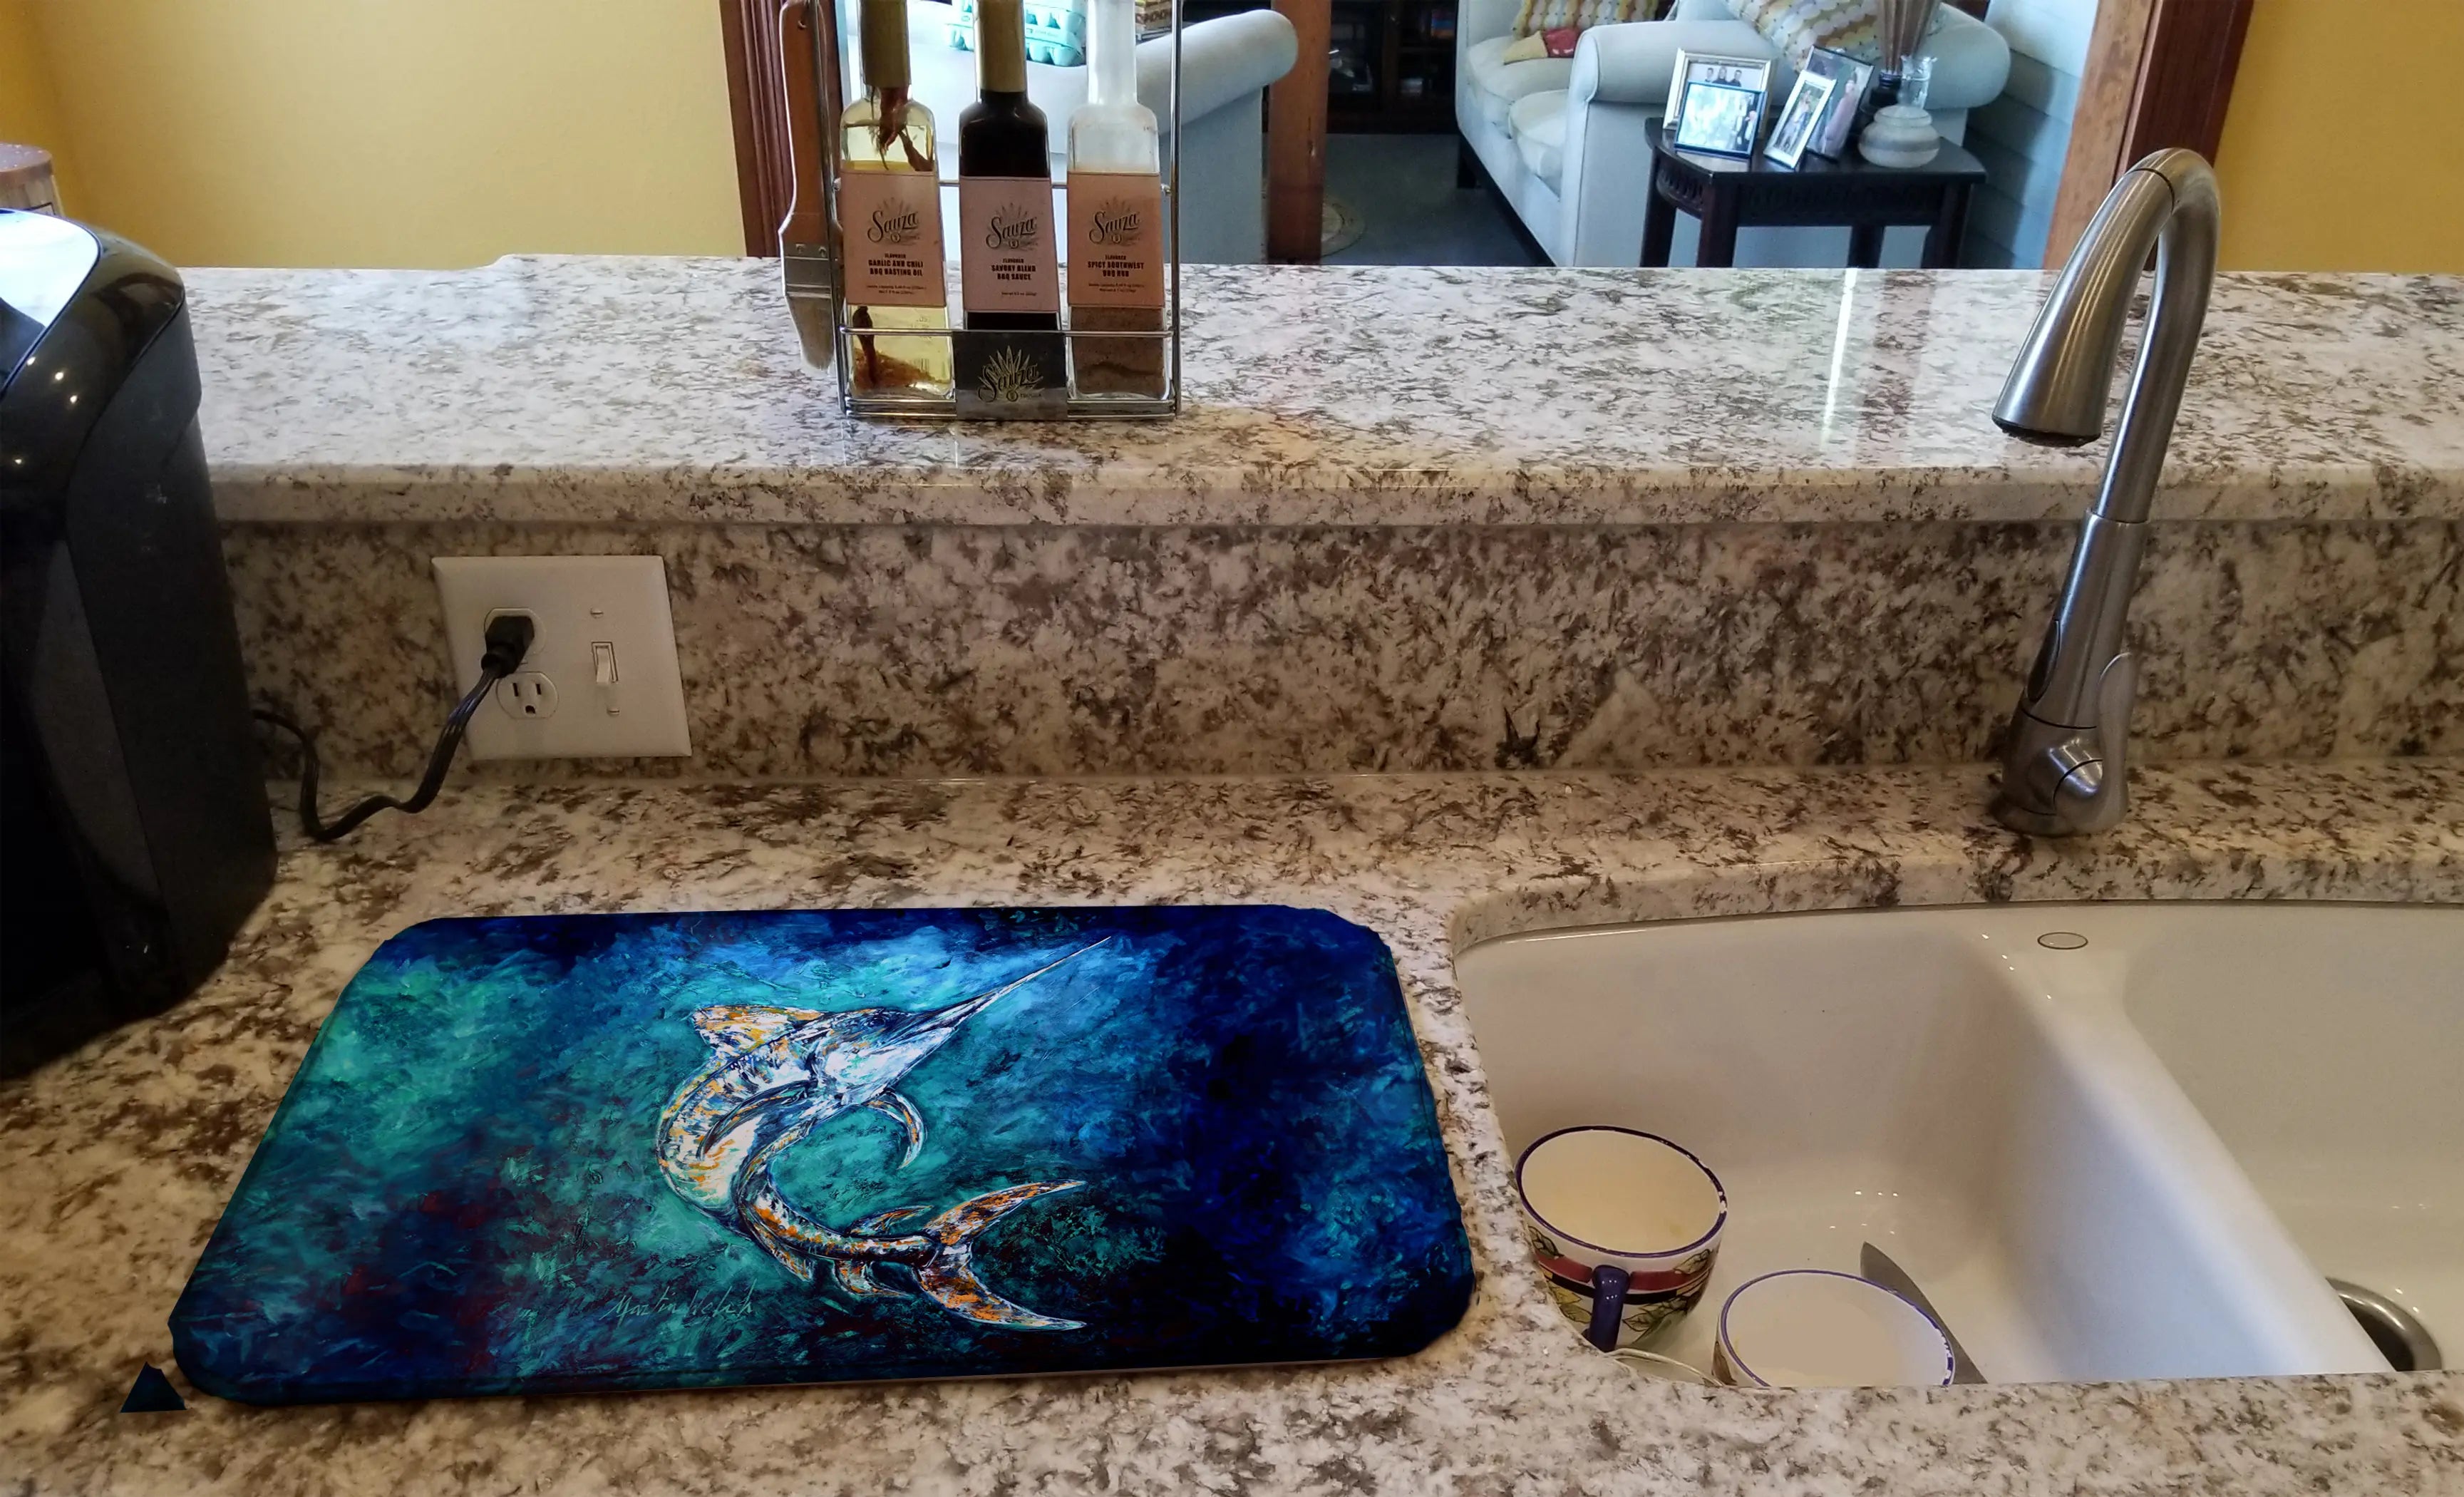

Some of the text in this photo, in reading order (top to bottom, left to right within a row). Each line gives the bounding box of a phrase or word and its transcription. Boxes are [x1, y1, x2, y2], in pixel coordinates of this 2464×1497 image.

[867, 210, 919, 242] Sauza
[986, 216, 1037, 250] Sauza
[1089, 211, 1140, 244] Sauza
